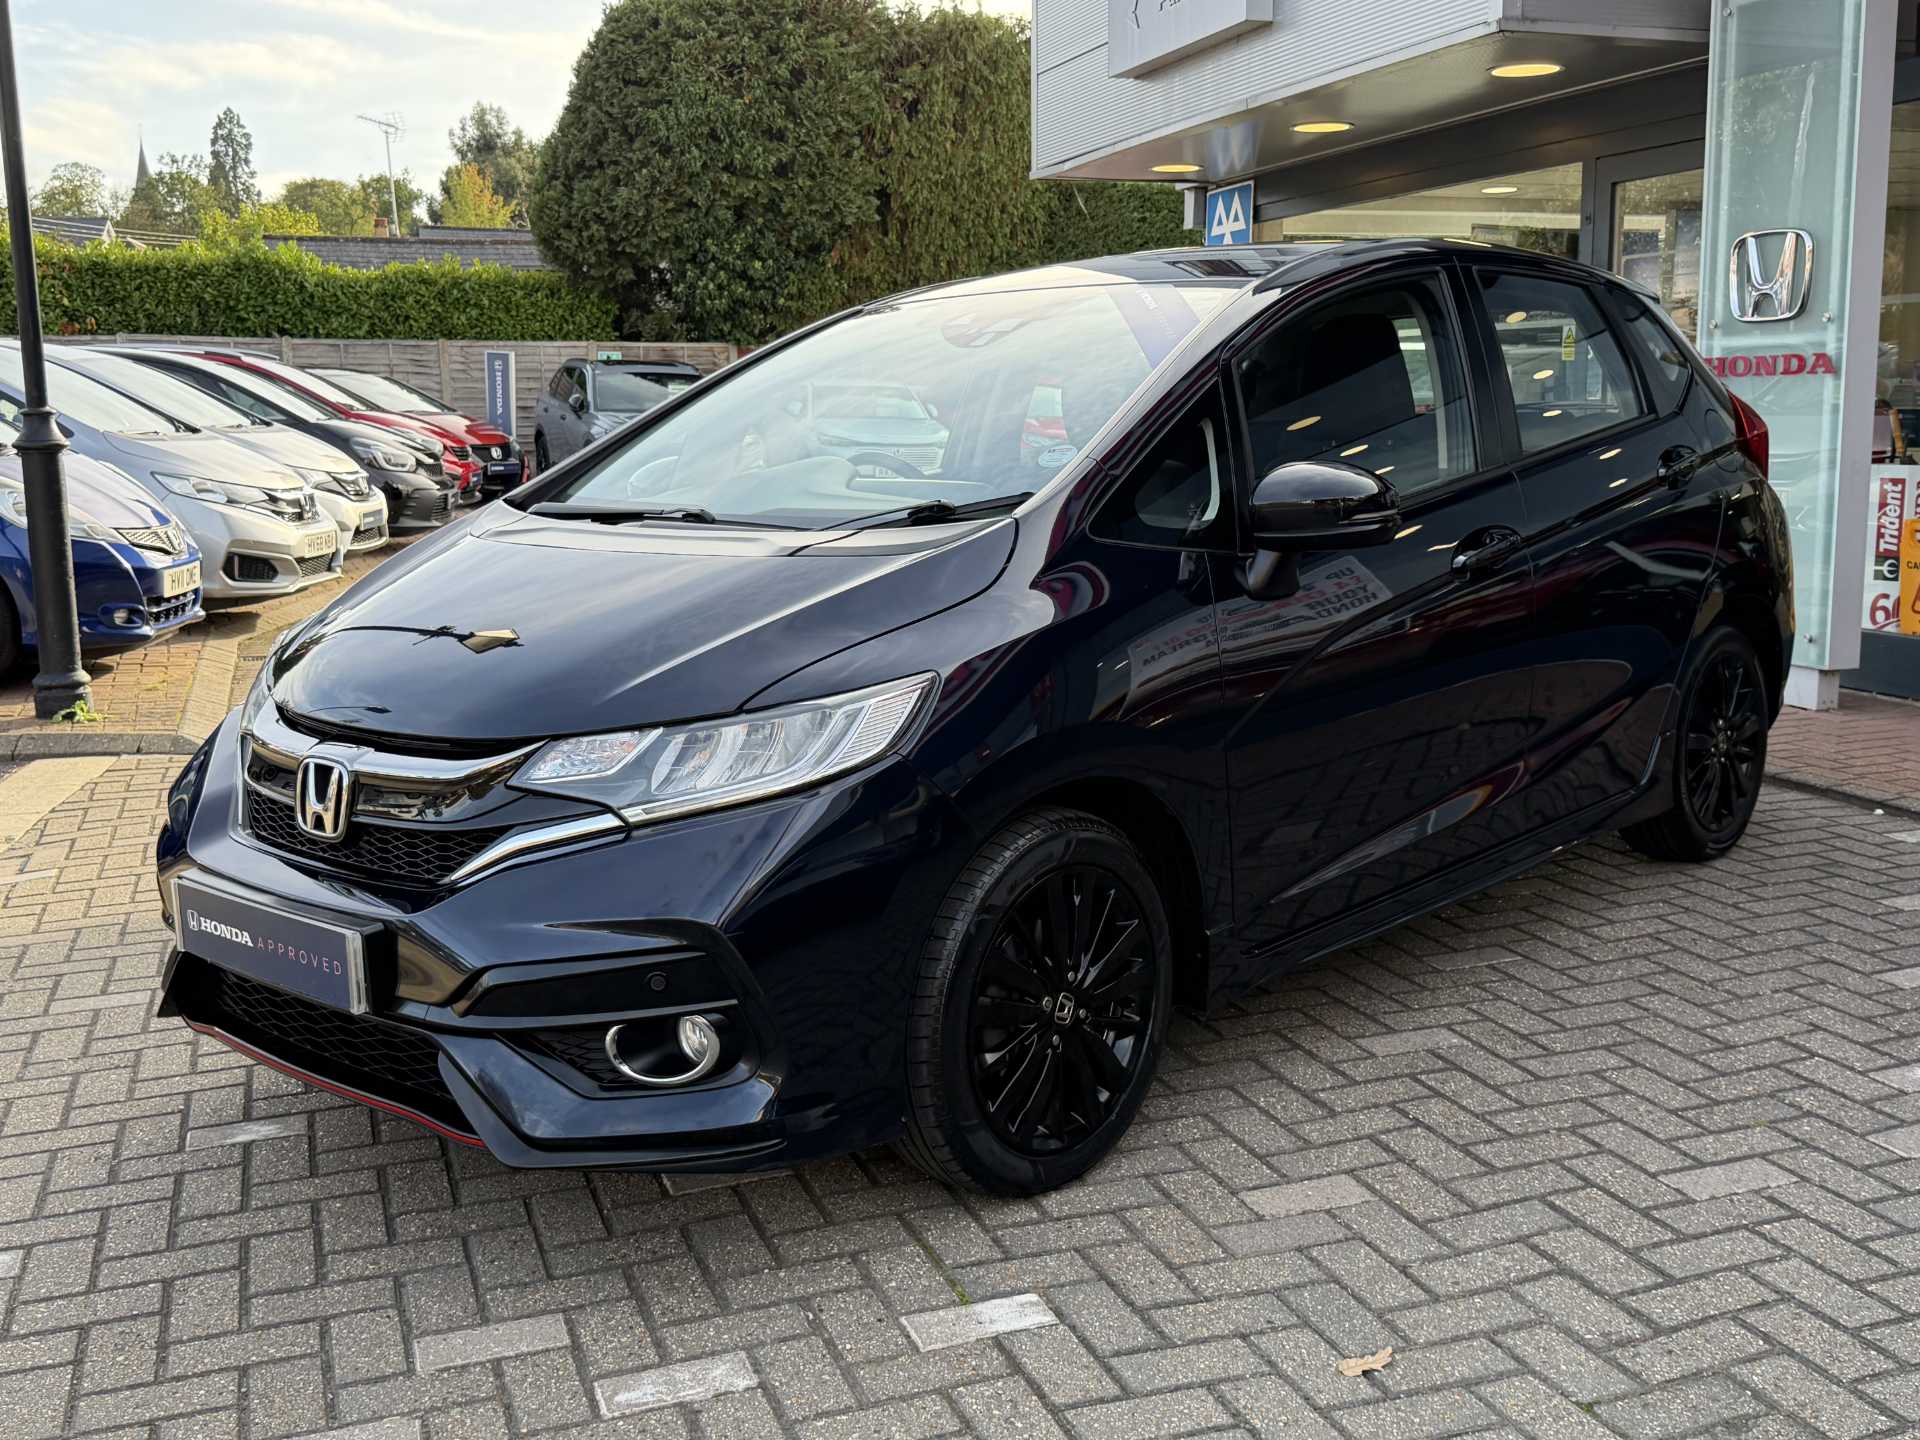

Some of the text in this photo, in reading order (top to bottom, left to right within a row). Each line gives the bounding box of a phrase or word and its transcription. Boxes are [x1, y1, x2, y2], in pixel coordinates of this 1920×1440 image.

[1704, 352, 1837, 377] HONDA
[495, 371, 503, 416] HONDA
[1879, 481, 1902, 552] Trident
[199, 917, 342, 975] HONDA APPROVED
